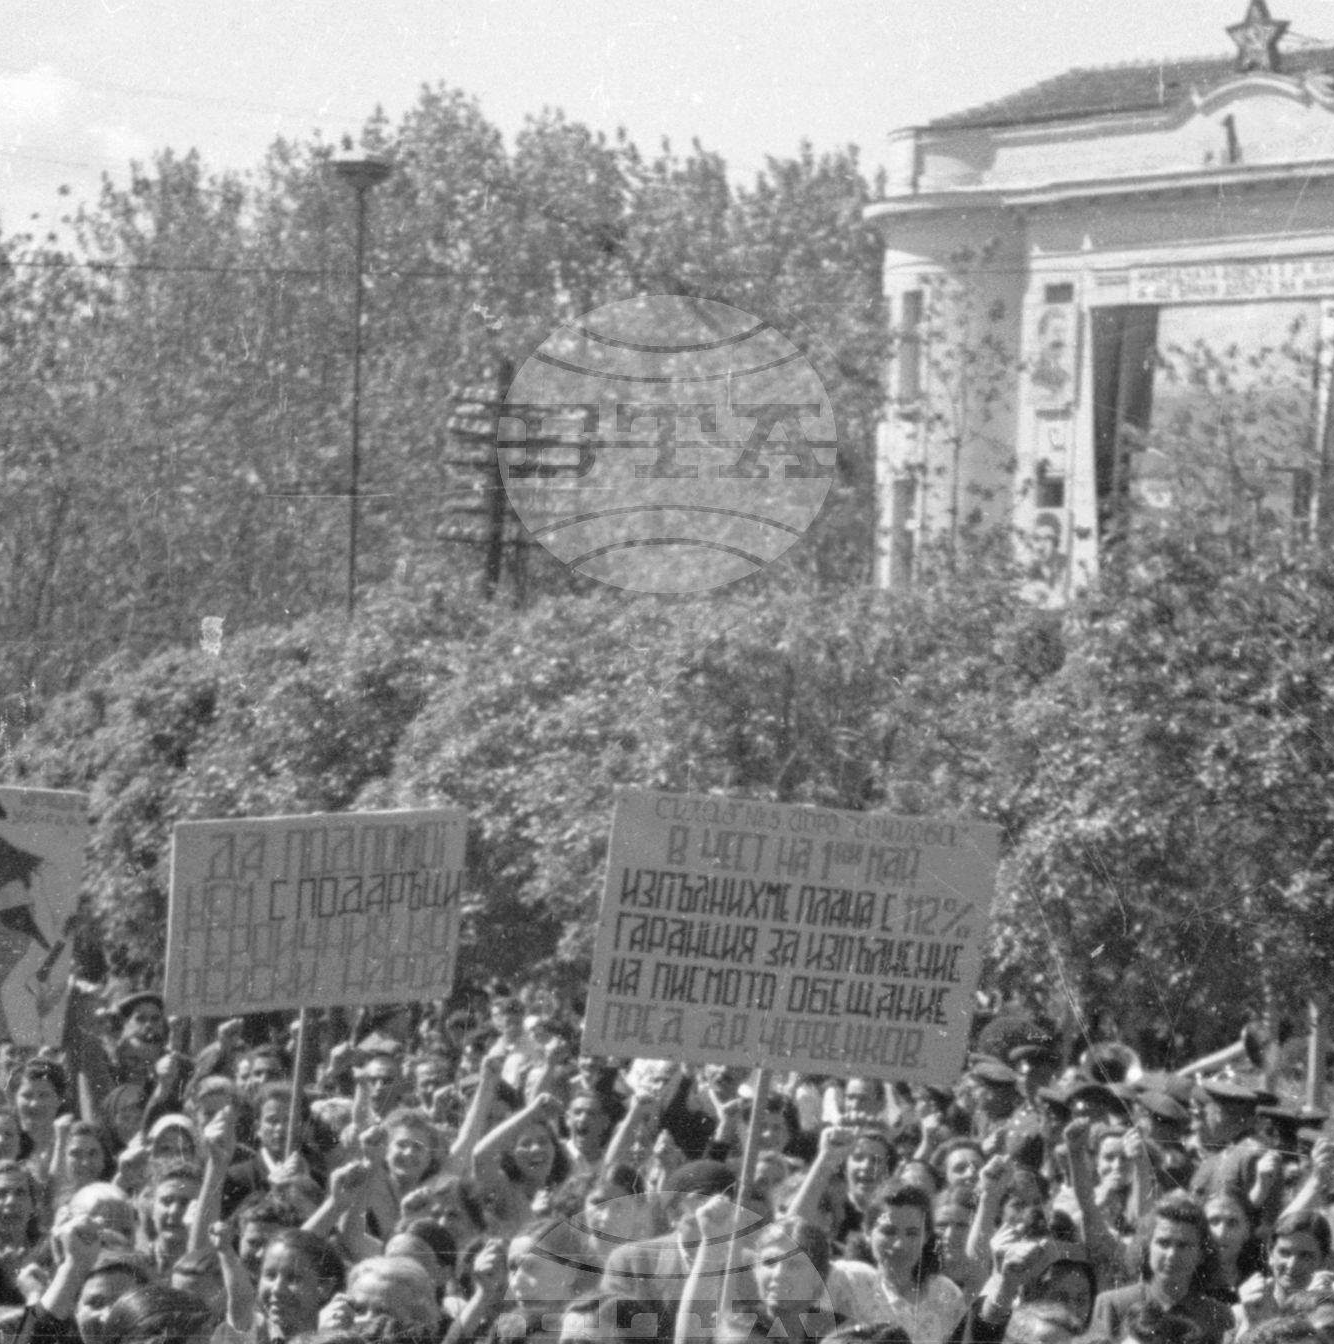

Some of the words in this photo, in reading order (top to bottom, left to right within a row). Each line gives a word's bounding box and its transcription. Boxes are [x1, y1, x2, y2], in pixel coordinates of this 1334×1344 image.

[205, 830, 266, 882] ДА
[664, 824, 691, 866] В
[697, 829, 768, 873] ЧЕСТ
[774, 837, 814, 877] НА
[268, 878, 288, 921] С
[296, 867, 461, 918] ПОДАРЪЦИ
[618, 867, 794, 922] ИЗПЪЛНИХМЕ
[795, 884, 877, 929] ПЛАНА
[878, 892, 899, 931] С
[611, 911, 760, 964] ГАРАНЦИЯ
[763, 927, 801, 967] ЗА
[803, 931, 966, 983] ИЗПЪЛНЕНИЕ
[605, 956, 643, 996] НА
[650, 961, 779, 1010] ПИСМОТО
[786, 973, 953, 1026] ОБЕЩАНИЕ
[599, 999, 688, 1047] ПРЕД
